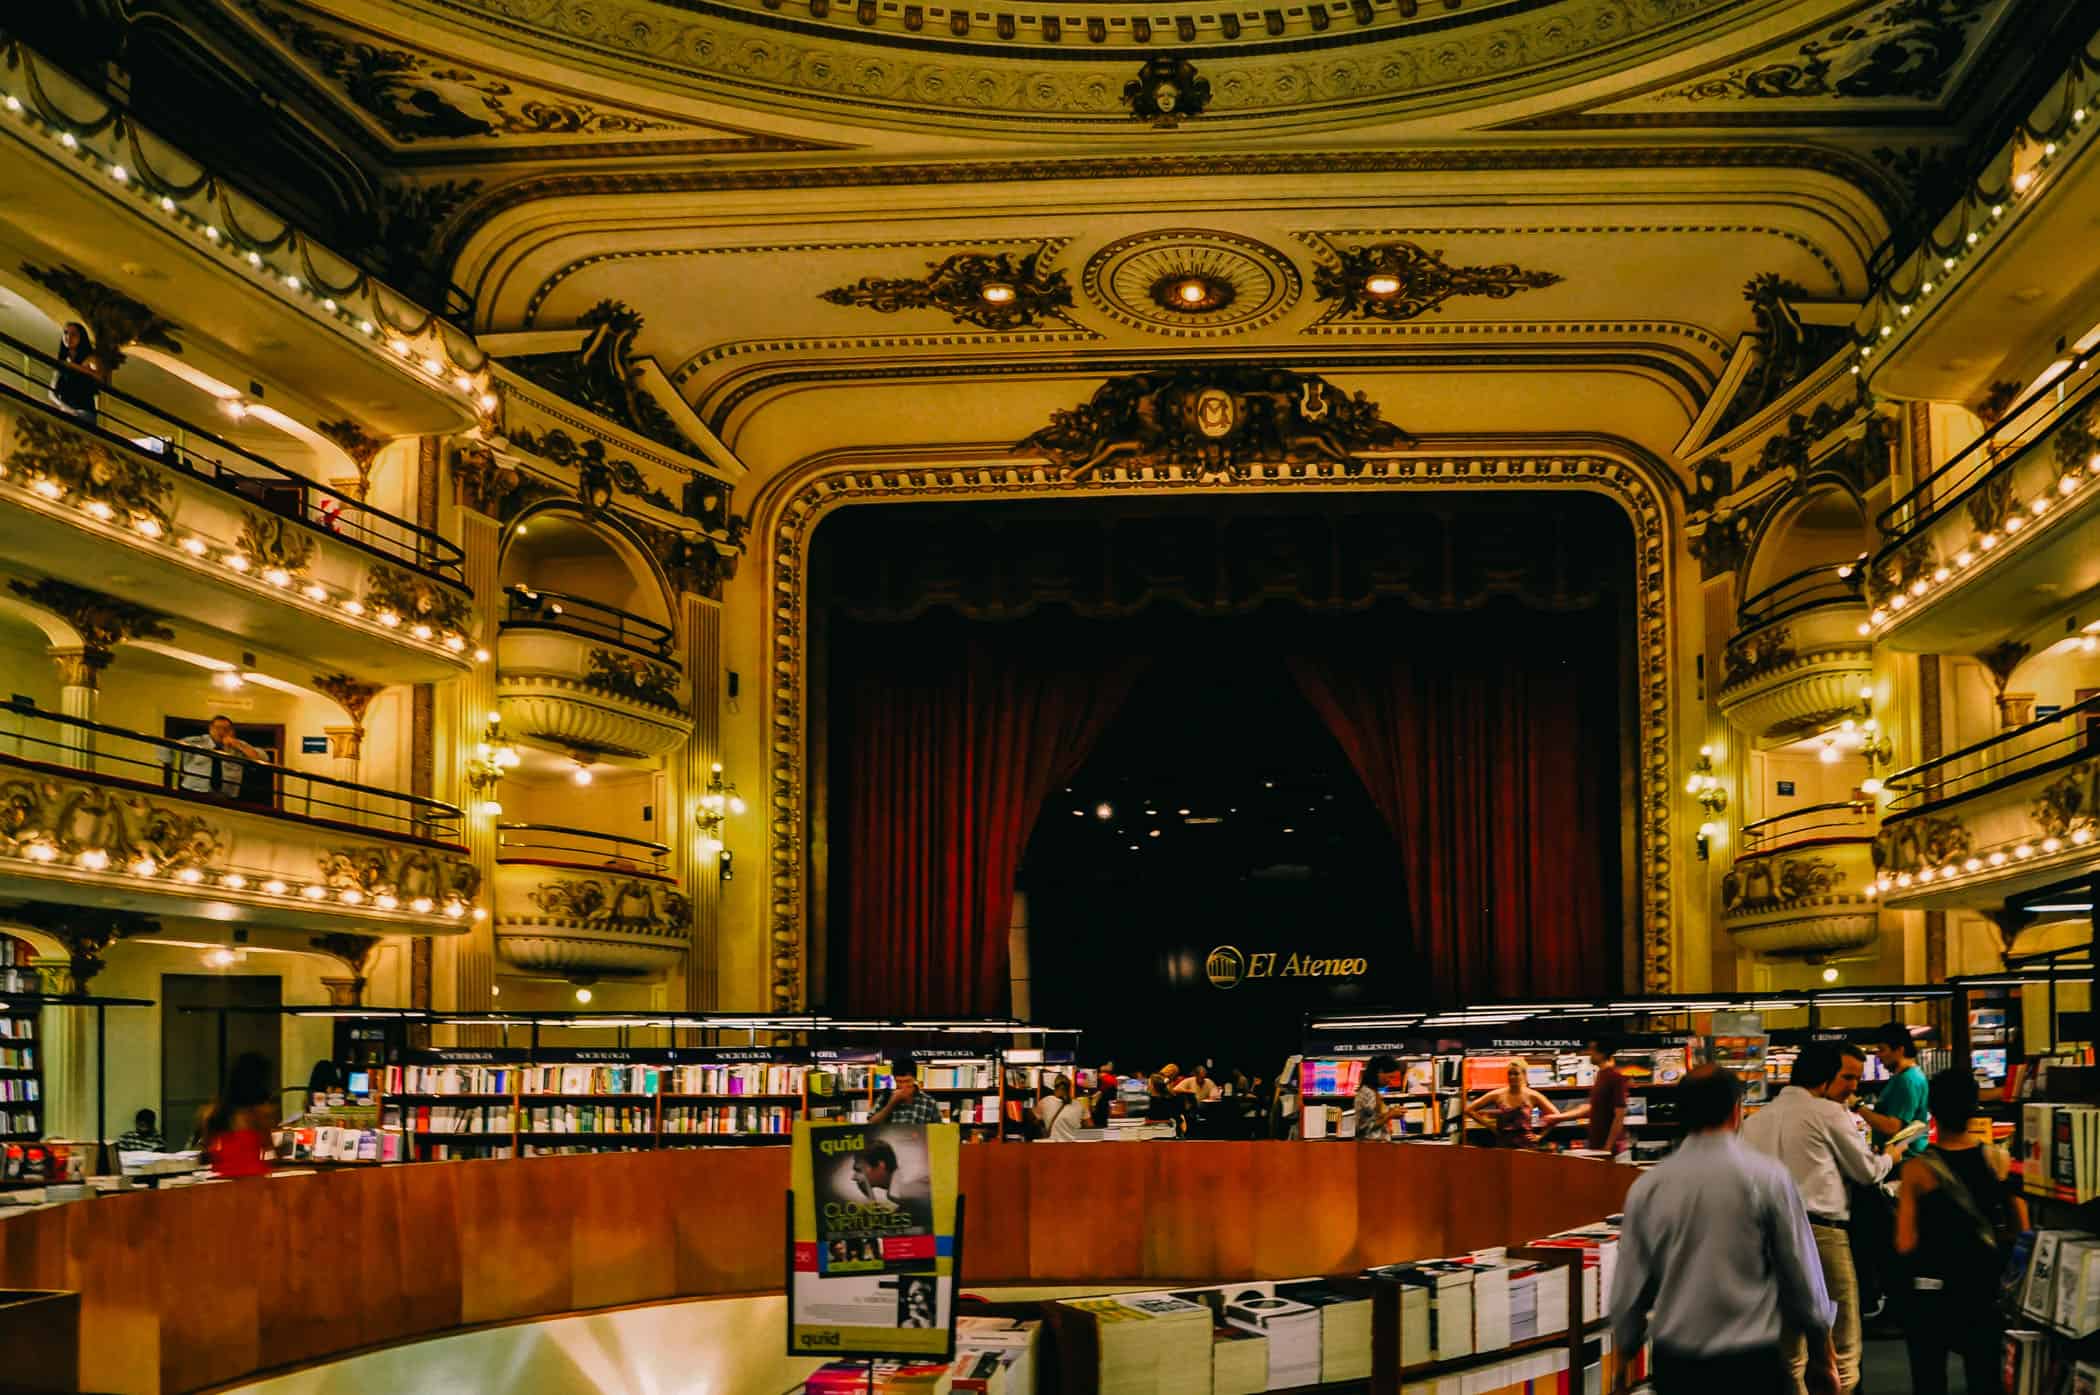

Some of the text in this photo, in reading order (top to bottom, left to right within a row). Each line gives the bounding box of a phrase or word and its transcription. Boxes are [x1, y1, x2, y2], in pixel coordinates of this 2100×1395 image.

[1248, 952, 1367, 978] El Ateneo
[1662, 1036, 1689, 1045] TURIS
